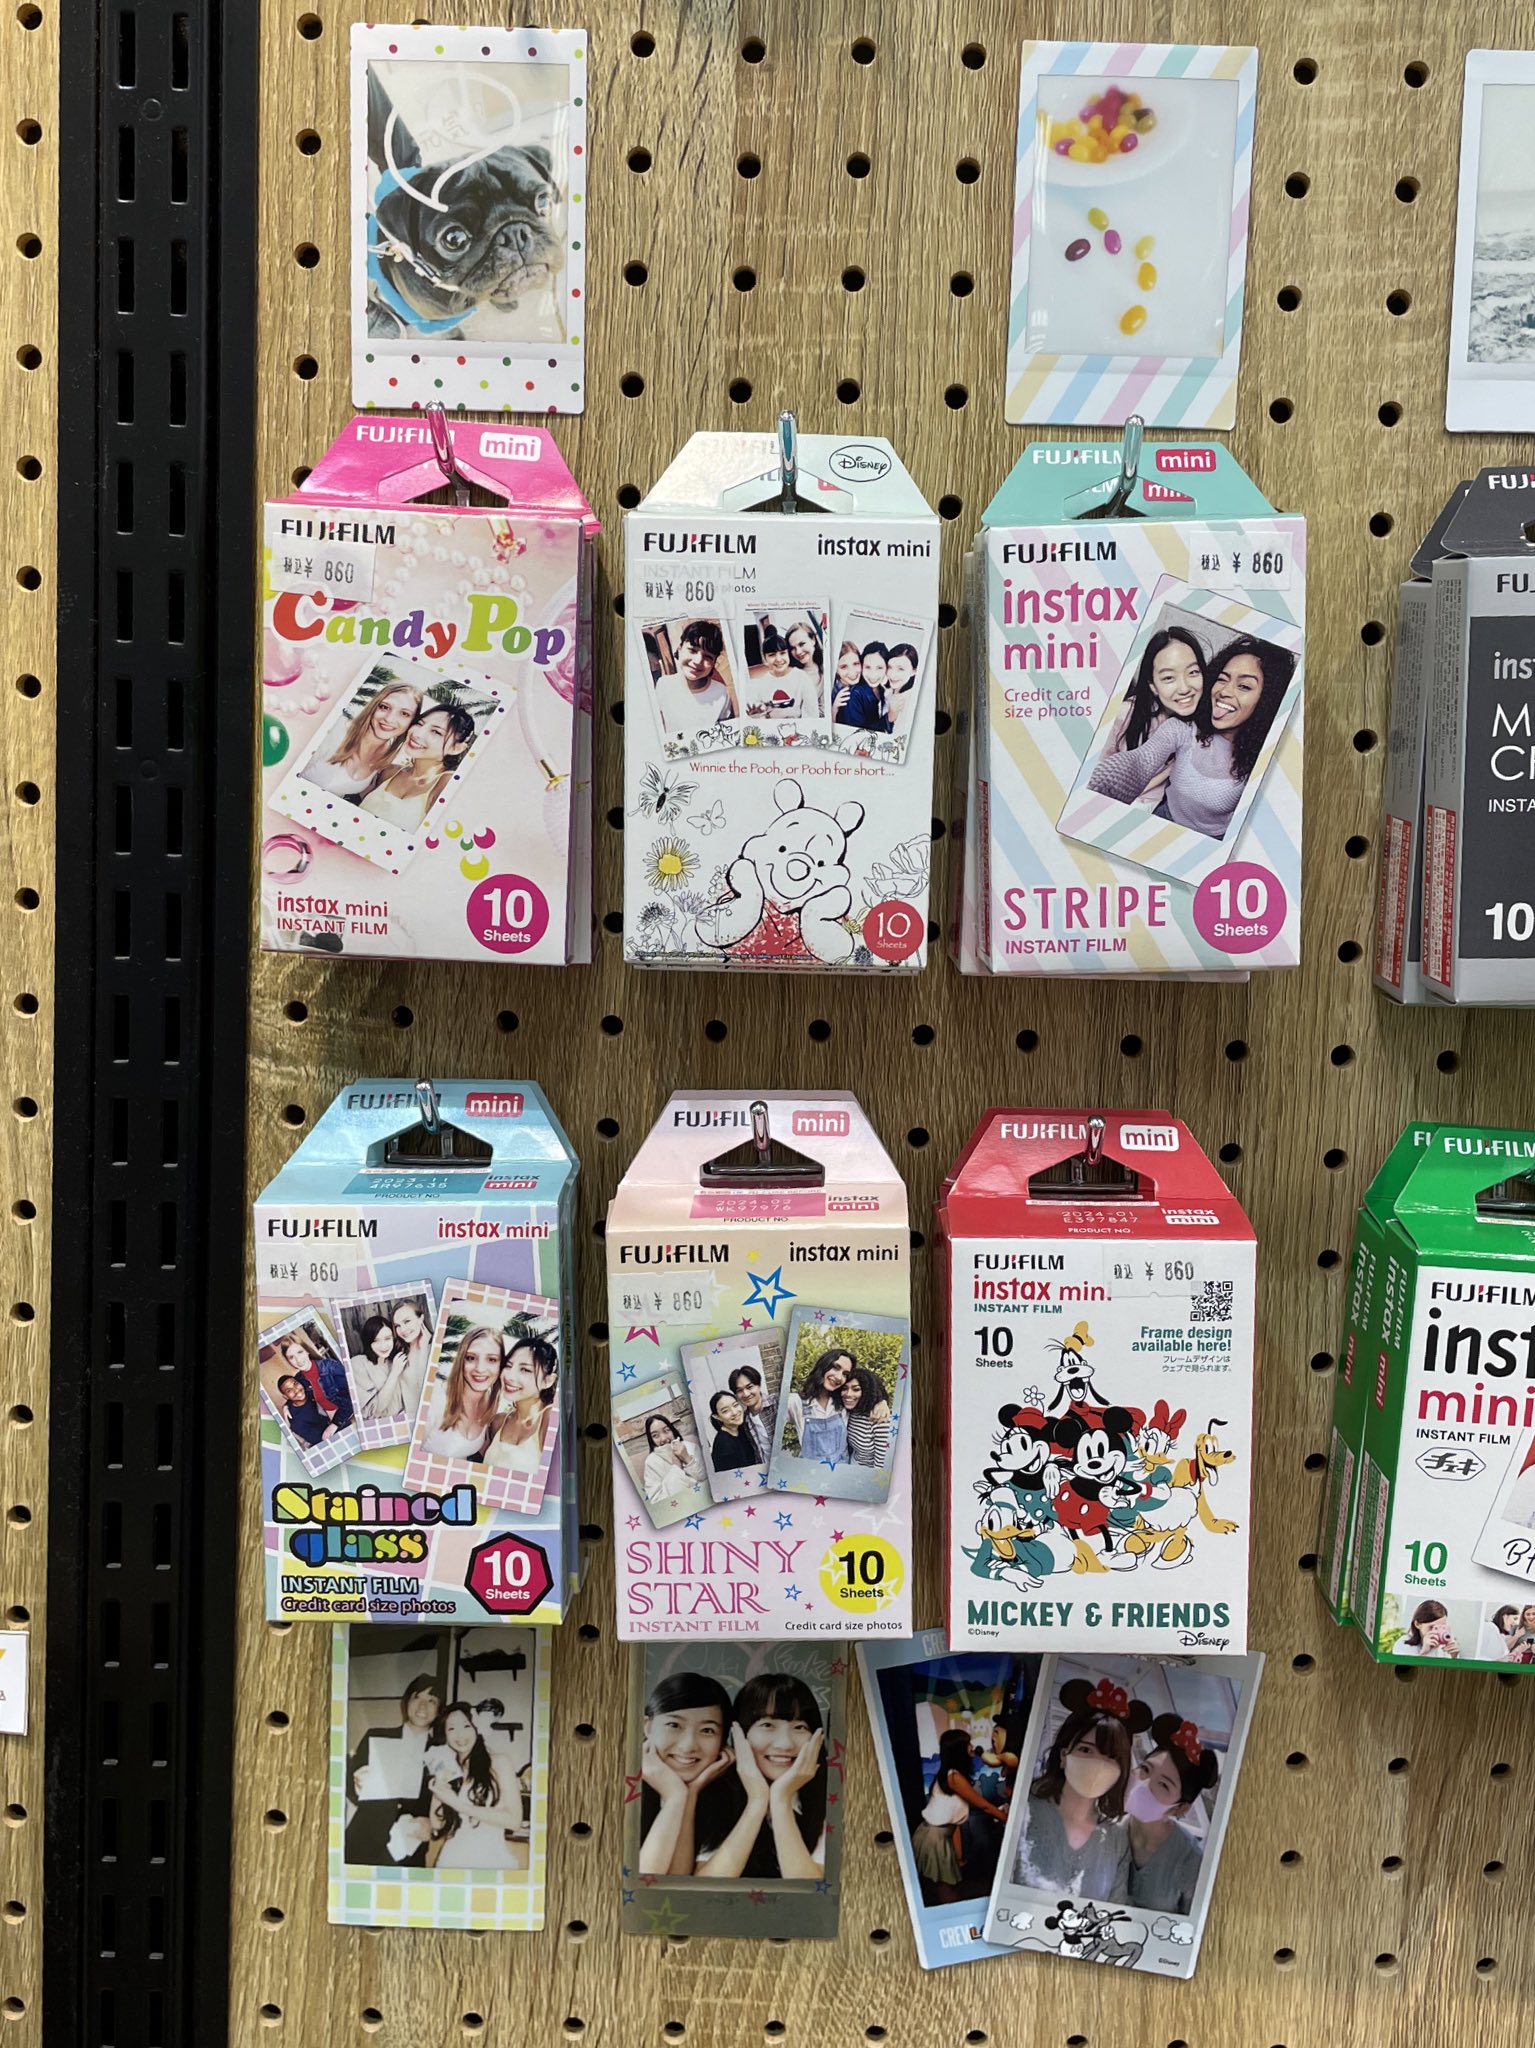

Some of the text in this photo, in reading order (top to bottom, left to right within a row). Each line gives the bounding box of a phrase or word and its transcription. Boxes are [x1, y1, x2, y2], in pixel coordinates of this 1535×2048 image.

[356, 425, 535, 457] FUJIFIL mini
[1161, 451, 1212, 469] mini
[281, 518, 396, 545] FUJIFILM
[643, 532, 931, 557] FUJIFILM instax mini
[1003, 541, 1117, 564] FUJIFILM
[324, 560, 354, 584] 860
[1232, 552, 1242, 574] ¥
[1252, 552, 1283, 575] 860
[685, 580, 715, 602] 860
[1003, 579, 1139, 625] instax
[273, 590, 566, 665] Candy Pop
[1004, 631, 1098, 671] mini
[1493, 651, 1535, 680] ins
[1004, 686, 1090, 702] Credit card
[1005, 703, 1093, 721] size photos
[689, 760, 895, 777] Winnie the Pooh, or Pooh for short...
[277, 891, 389, 917] instax mini
[483, 887, 533, 929] 10
[1004, 885, 1167, 931] STRIPE
[1210, 878, 1268, 920] 10
[277, 917, 389, 936] INSTANT FILM
[876, 912, 911, 940] 10
[1213, 922, 1269, 938] Sheets
[1485, 902, 1535, 942] 10
[483, 929, 532, 943] Sheets
[876, 939, 907, 950] Sheets
[1005, 938, 1127, 955] INSTANT FILM
[347, 1093, 520, 1115] FUJIFIL mini
[673, 1110, 846, 1133] FUJIFIL mini
[1125, 1127, 1174, 1148] mini
[489, 1181, 534, 1189] mini
[832, 1203, 875, 1211] mini
[1161, 1208, 1216, 1216] instax
[268, 1218, 549, 1239] FUJIFILM instax mini
[1170, 1216, 1215, 1224] mini
[620, 1241, 899, 1264] FUJIFILM instax mini
[974, 1254, 1065, 1271] FUJIFILM
[309, 1262, 339, 1283] 860
[1164, 1260, 1194, 1281] 860
[974, 1274, 1051, 1301] instax
[1351, 1242, 1370, 1327] instax
[673, 1290, 703, 1311] 860
[974, 1303, 1063, 1315] INSTANT FILM
[1381, 1256, 1400, 1345] instax
[974, 1326, 1014, 1357] 10
[1140, 1326, 1232, 1341] Frame design
[1132, 1339, 1232, 1352] available here!
[975, 1357, 1014, 1369] Sheets
[1163, 1355, 1231, 1363] フレームデザインは
[1376, 1354, 1386, 1407] mini
[1417, 1382, 1535, 1427] mini
[1416, 1428, 1511, 1446] INSTANT FILM
[1423, 1452, 1479, 1476] チェキ
[272, 1483, 477, 1526] Stained
[290, 1525, 428, 1568] glass
[626, 1540, 808, 1575] SHINY
[1405, 1540, 1448, 1575] 10
[483, 1550, 531, 1587] 10
[838, 1550, 885, 1585] 10
[281, 1576, 419, 1594] INSTANT FILM
[1404, 1573, 1447, 1587] Sheets
[485, 1588, 531, 1600] Sheets
[628, 1581, 771, 1615] STAR
[840, 1587, 885, 1599] Sheets
[281, 1598, 456, 1616] Credit card size photos
[967, 1600, 1230, 1628] MICKEY & FRIENDS
[629, 1619, 760, 1633] INSTANT FILM
[785, 1620, 903, 1633] Credit card size photos
